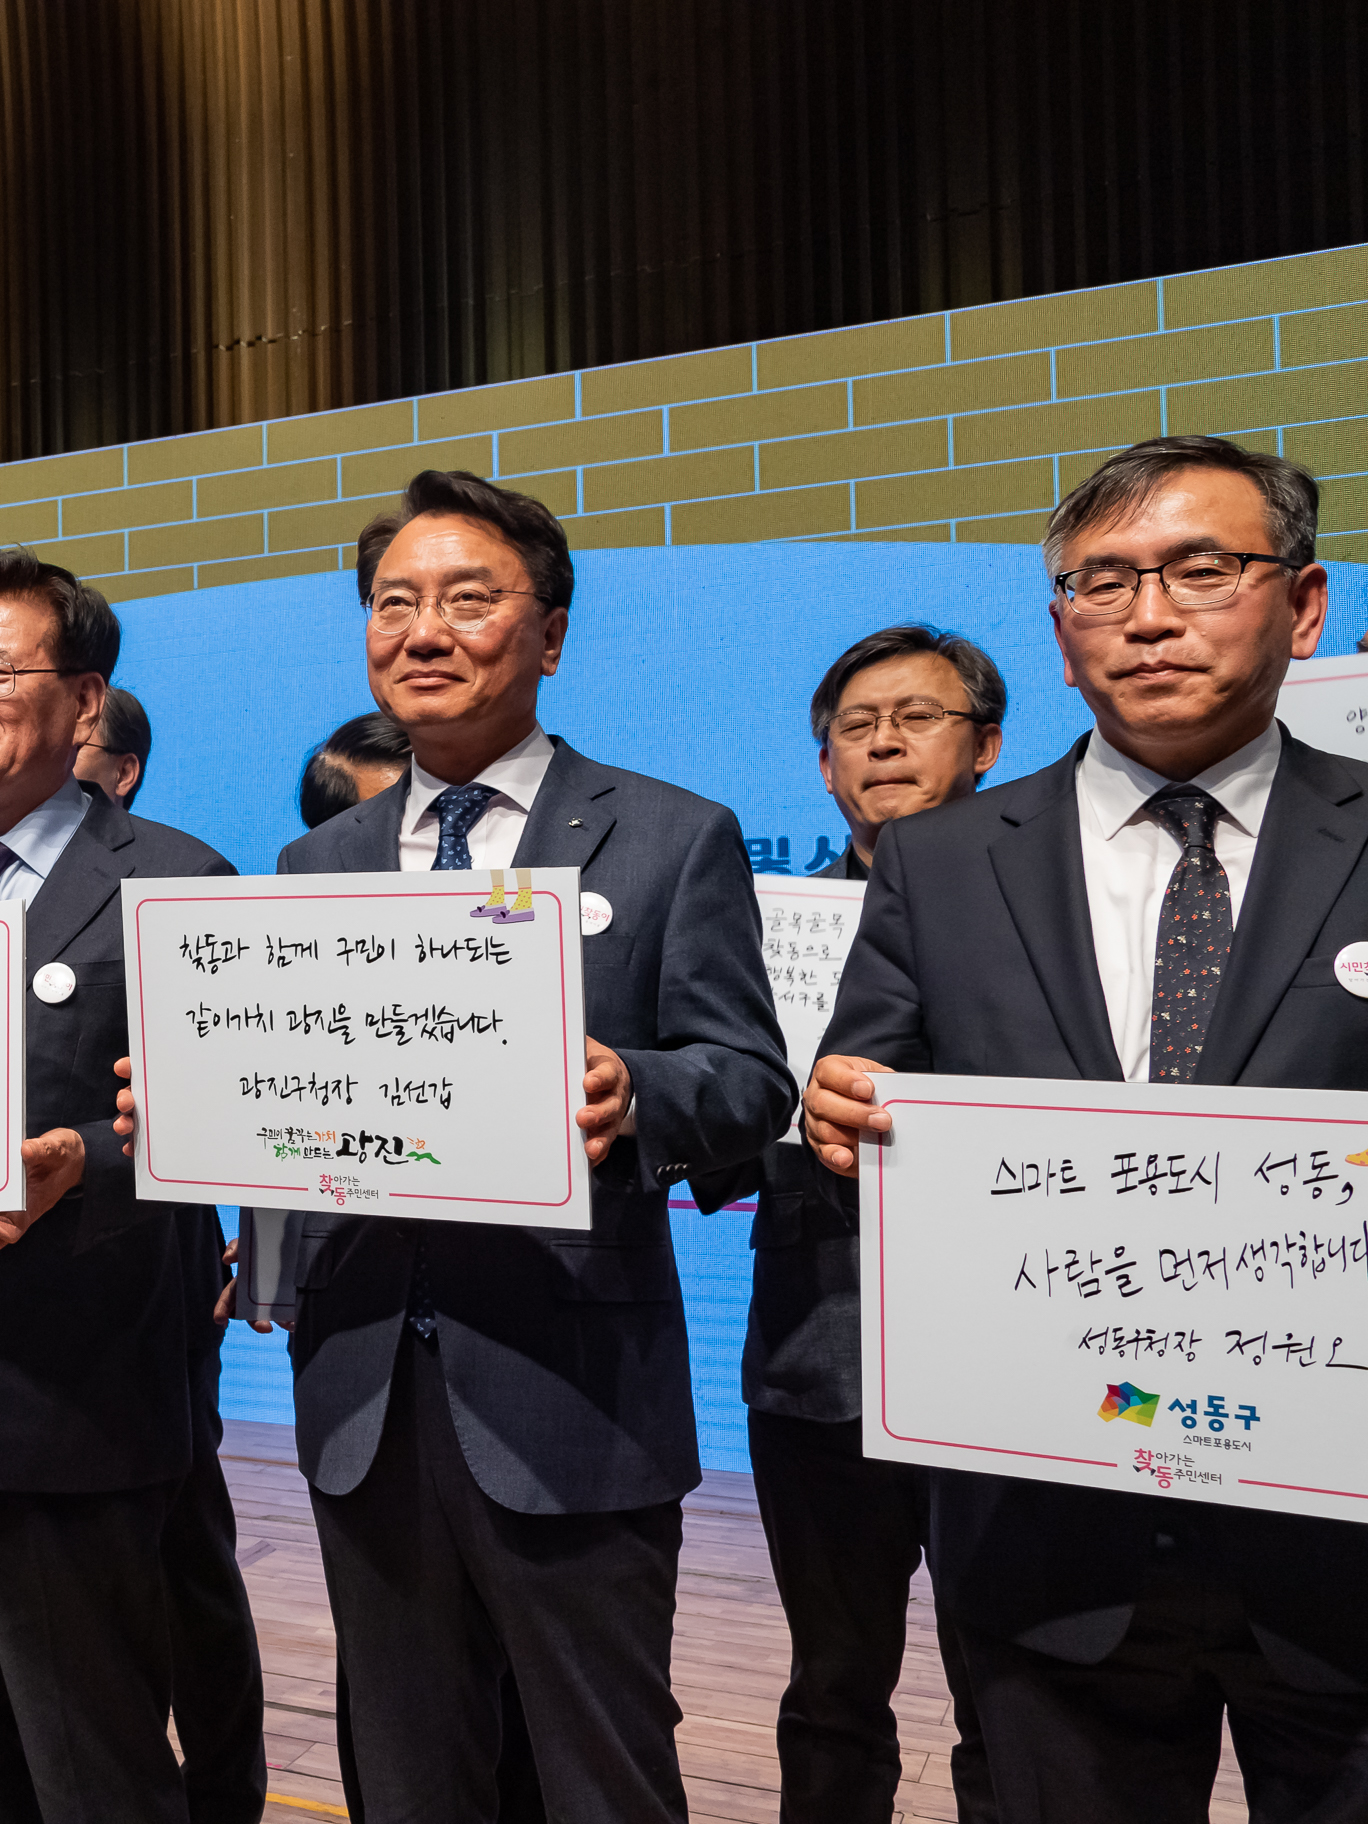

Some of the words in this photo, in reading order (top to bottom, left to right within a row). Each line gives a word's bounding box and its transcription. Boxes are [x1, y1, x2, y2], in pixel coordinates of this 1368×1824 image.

[178, 933, 251, 975] 찾동과
[265, 934, 319, 969] 함께
[336, 934, 396, 967] 구민이
[414, 933, 513, 966] 하나되는
[185, 1001, 274, 1038] 같이가치
[285, 1002, 356, 1046] 광진을
[365, 1003, 508, 1047] 만들겠습니다.
[239, 1071, 359, 1107] 광진구청장
[378, 1076, 454, 1111] 김선갑
[336, 1129, 409, 1165] 광진
[319, 1173, 361, 1195] 찾아가는
[333, 1187, 379, 1206] 동주민센터
[990, 1156, 1087, 1197] 스마트
[1110, 1151, 1221, 1205] 포용도시
[1253, 1150, 1354, 1206] 성동,
[1014, 1245, 1144, 1299] 사람을
[1077, 1326, 1203, 1363] 성동구청장
[1167, 1394, 1261, 1433] 성동구
[1134, 1448, 1195, 1472] 찾아가는
[1154, 1465, 1223, 1490] 동주민센터
